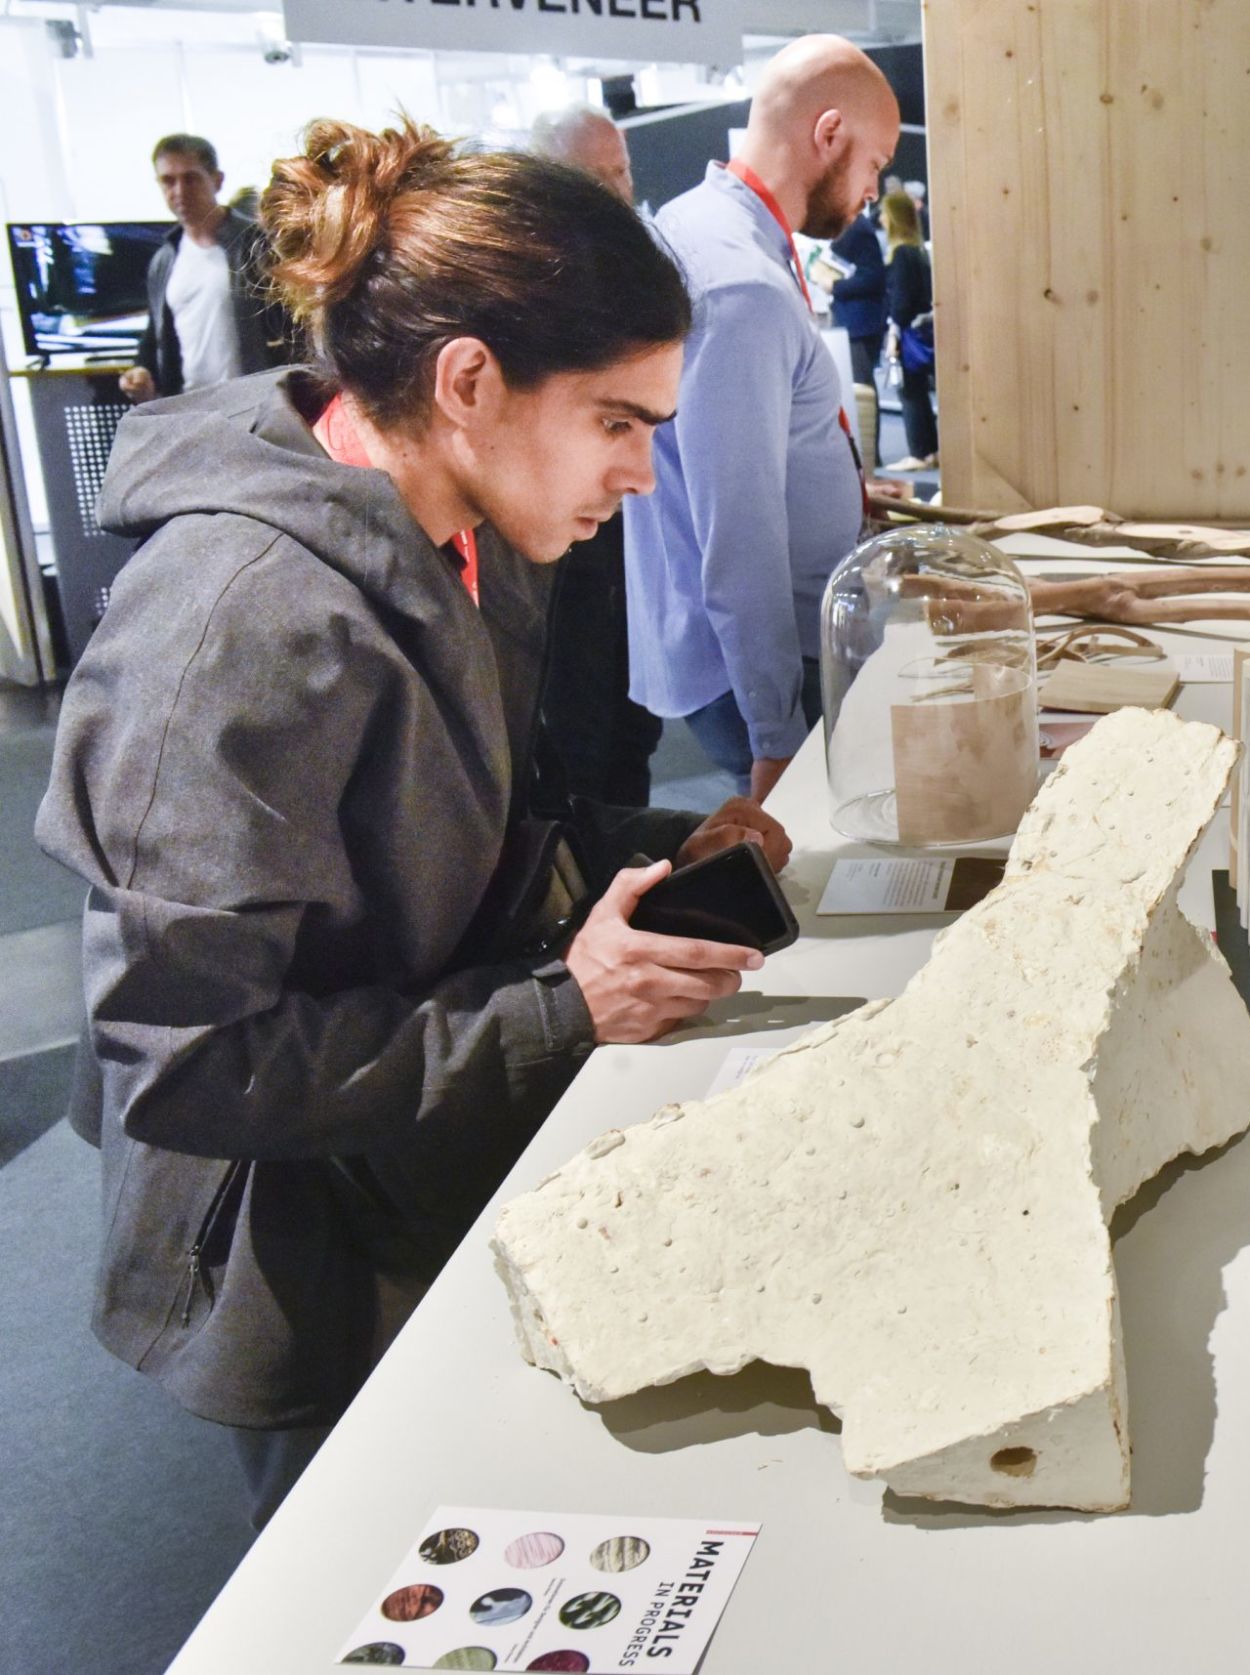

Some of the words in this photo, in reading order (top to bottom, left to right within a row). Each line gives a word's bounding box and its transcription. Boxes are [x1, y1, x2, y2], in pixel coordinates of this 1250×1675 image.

[646, 1540, 724, 1658] MATERIALS
[655, 1581, 675, 1598] IN
[618, 1602, 665, 1667] PROGRESS
